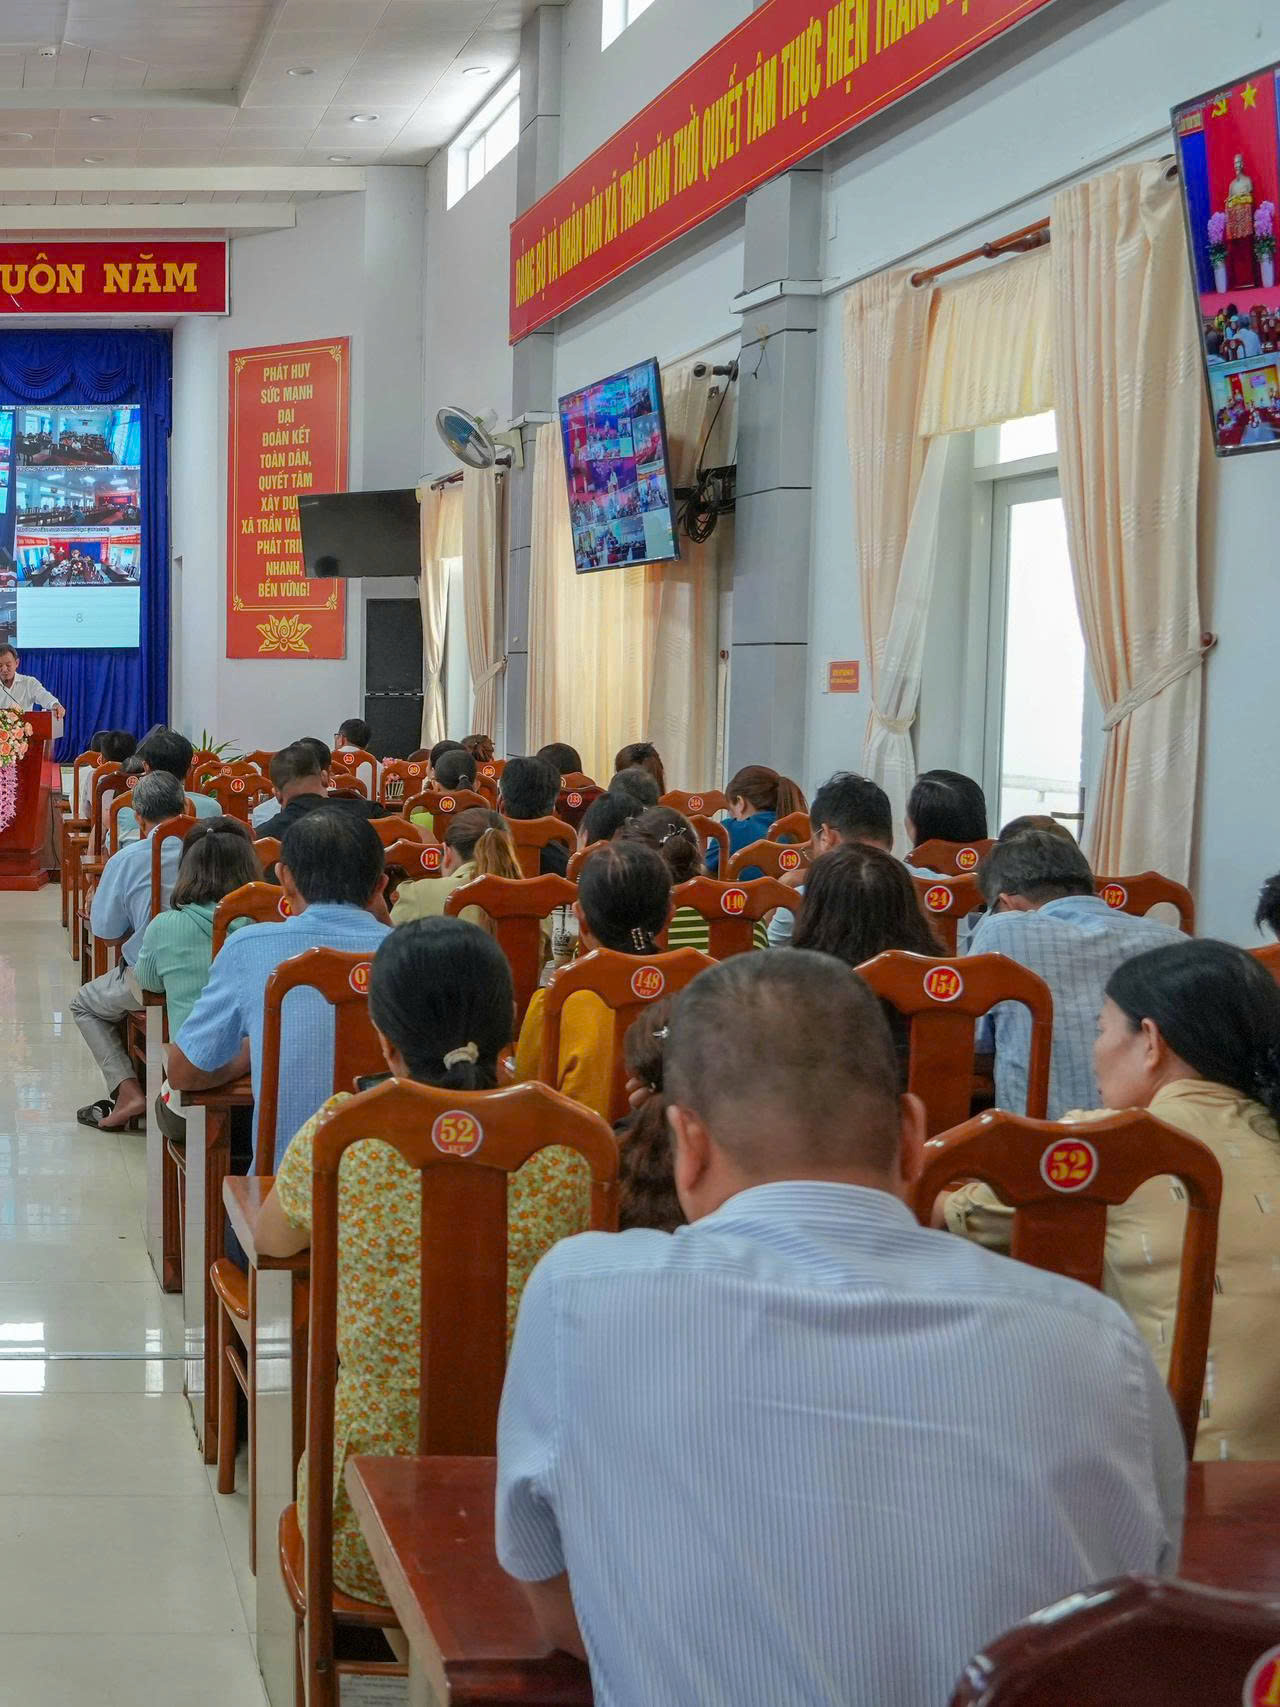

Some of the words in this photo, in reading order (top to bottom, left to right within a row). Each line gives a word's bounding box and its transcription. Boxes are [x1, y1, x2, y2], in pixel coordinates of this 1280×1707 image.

[584, 185, 603, 260] DÂN
[604, 170, 617, 245] XÃ
[649, 131, 670, 213] VĂN
[673, 103, 699, 196] THỜI
[702, 63, 743, 182] QUYẾT
[746, 51, 777, 145] TÂM
[781, 16, 822, 124] THỰC
[103, 253, 197, 293] NĂM
[263, 363, 288, 382] PHÁT
[291, 363, 310, 379] HUY
[260, 386, 280, 404] SỨC
[283, 384, 313, 404] MẠNH
[278, 408, 295, 426] ĐẠI
[262, 428, 289, 447] ĐOÀN
[292, 424, 310, 444] KẾT
[260, 450, 285, 469] TOÀN
[288, 448, 312, 467] DÂN,
[259, 470, 289, 492] QUYẾT
[291, 470, 313, 488] TÂM
[261, 494, 280, 512] XÂY
[241, 517, 254, 534] XÃ
[257, 514, 282, 533] TRẦN
[257, 537, 281, 554] PHÁT
[266, 561, 303, 577] NHANH,
[258, 578, 277, 597] BỀN
[280, 579, 310, 597] VỮNG!
[424, 853, 438, 865] 121
[783, 854, 797, 867] 139
[960, 854, 976, 865] 62
[929, 893, 947, 906] 24
[1104, 890, 1121, 905] 137
[637, 970, 659, 989] 148
[930, 973, 956, 996] 154
[440, 1118, 474, 1143] 52
[1049, 1151, 1087, 1180] 52
